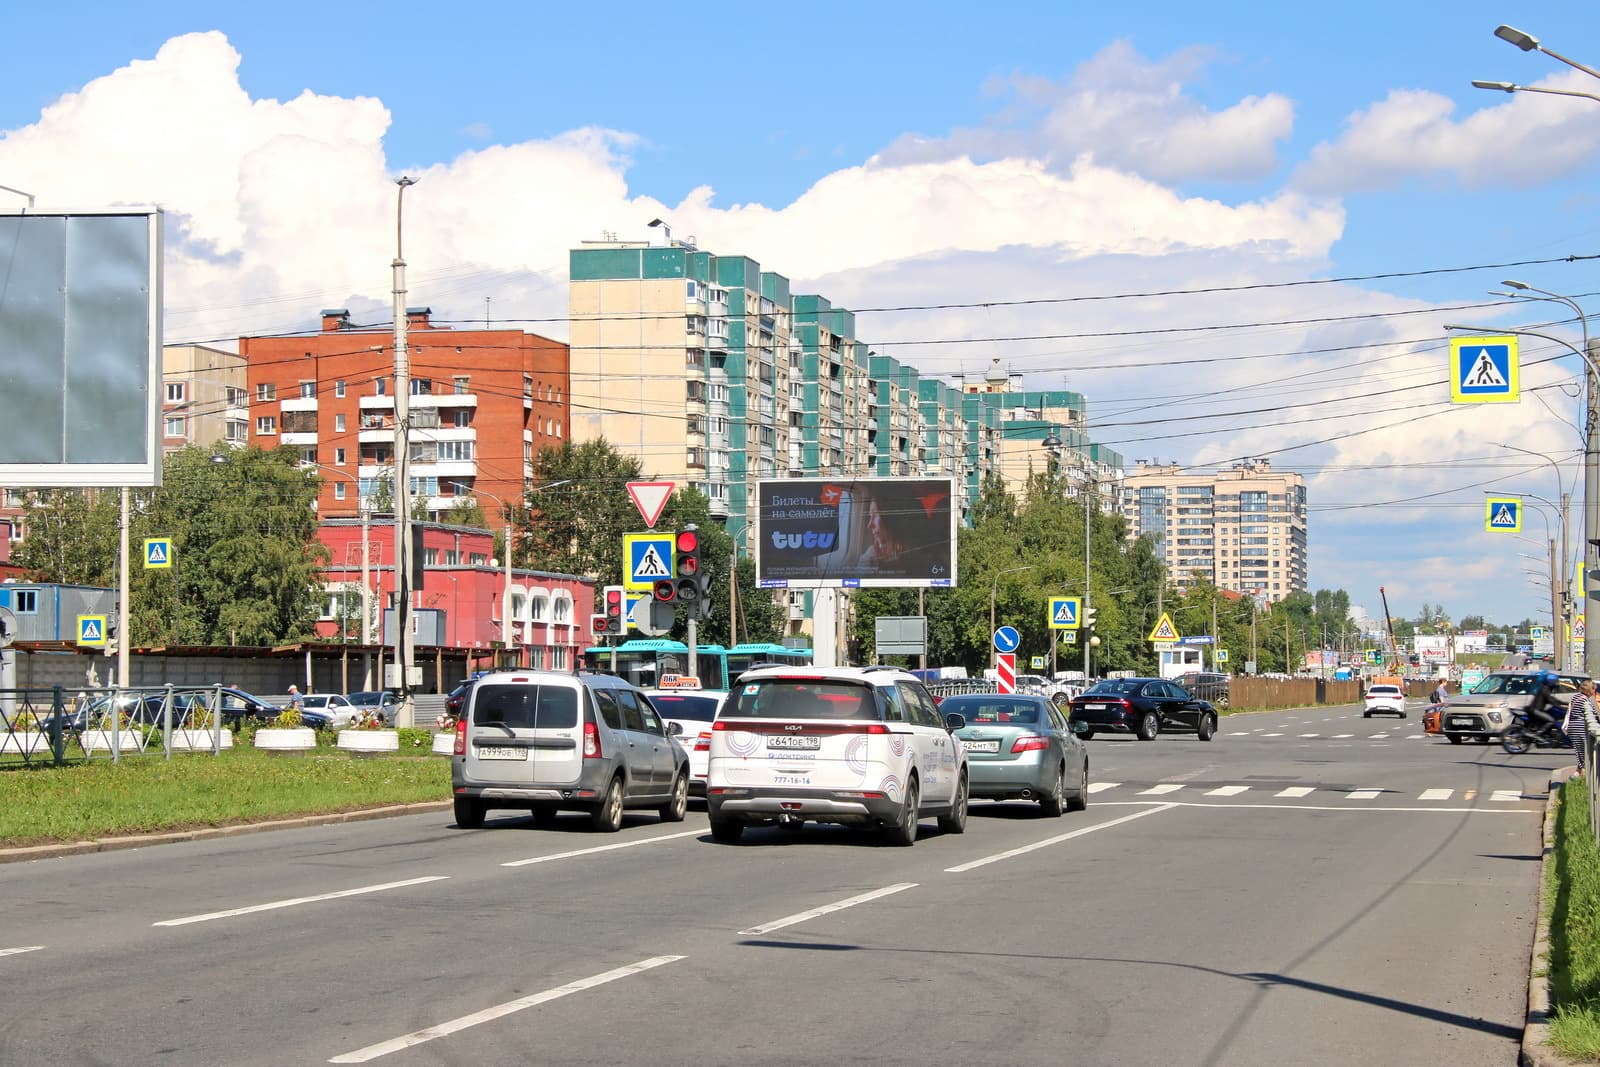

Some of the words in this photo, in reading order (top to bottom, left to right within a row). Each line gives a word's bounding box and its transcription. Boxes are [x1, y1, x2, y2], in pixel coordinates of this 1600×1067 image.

[772, 495, 814, 506] Билеты
[772, 510, 786, 518] на
[788, 507, 835, 519] самолёт
[771, 530, 835, 549] tutu
[931, 564, 945, 574] 6+
[774, 776, 811, 785] 777-16-16
